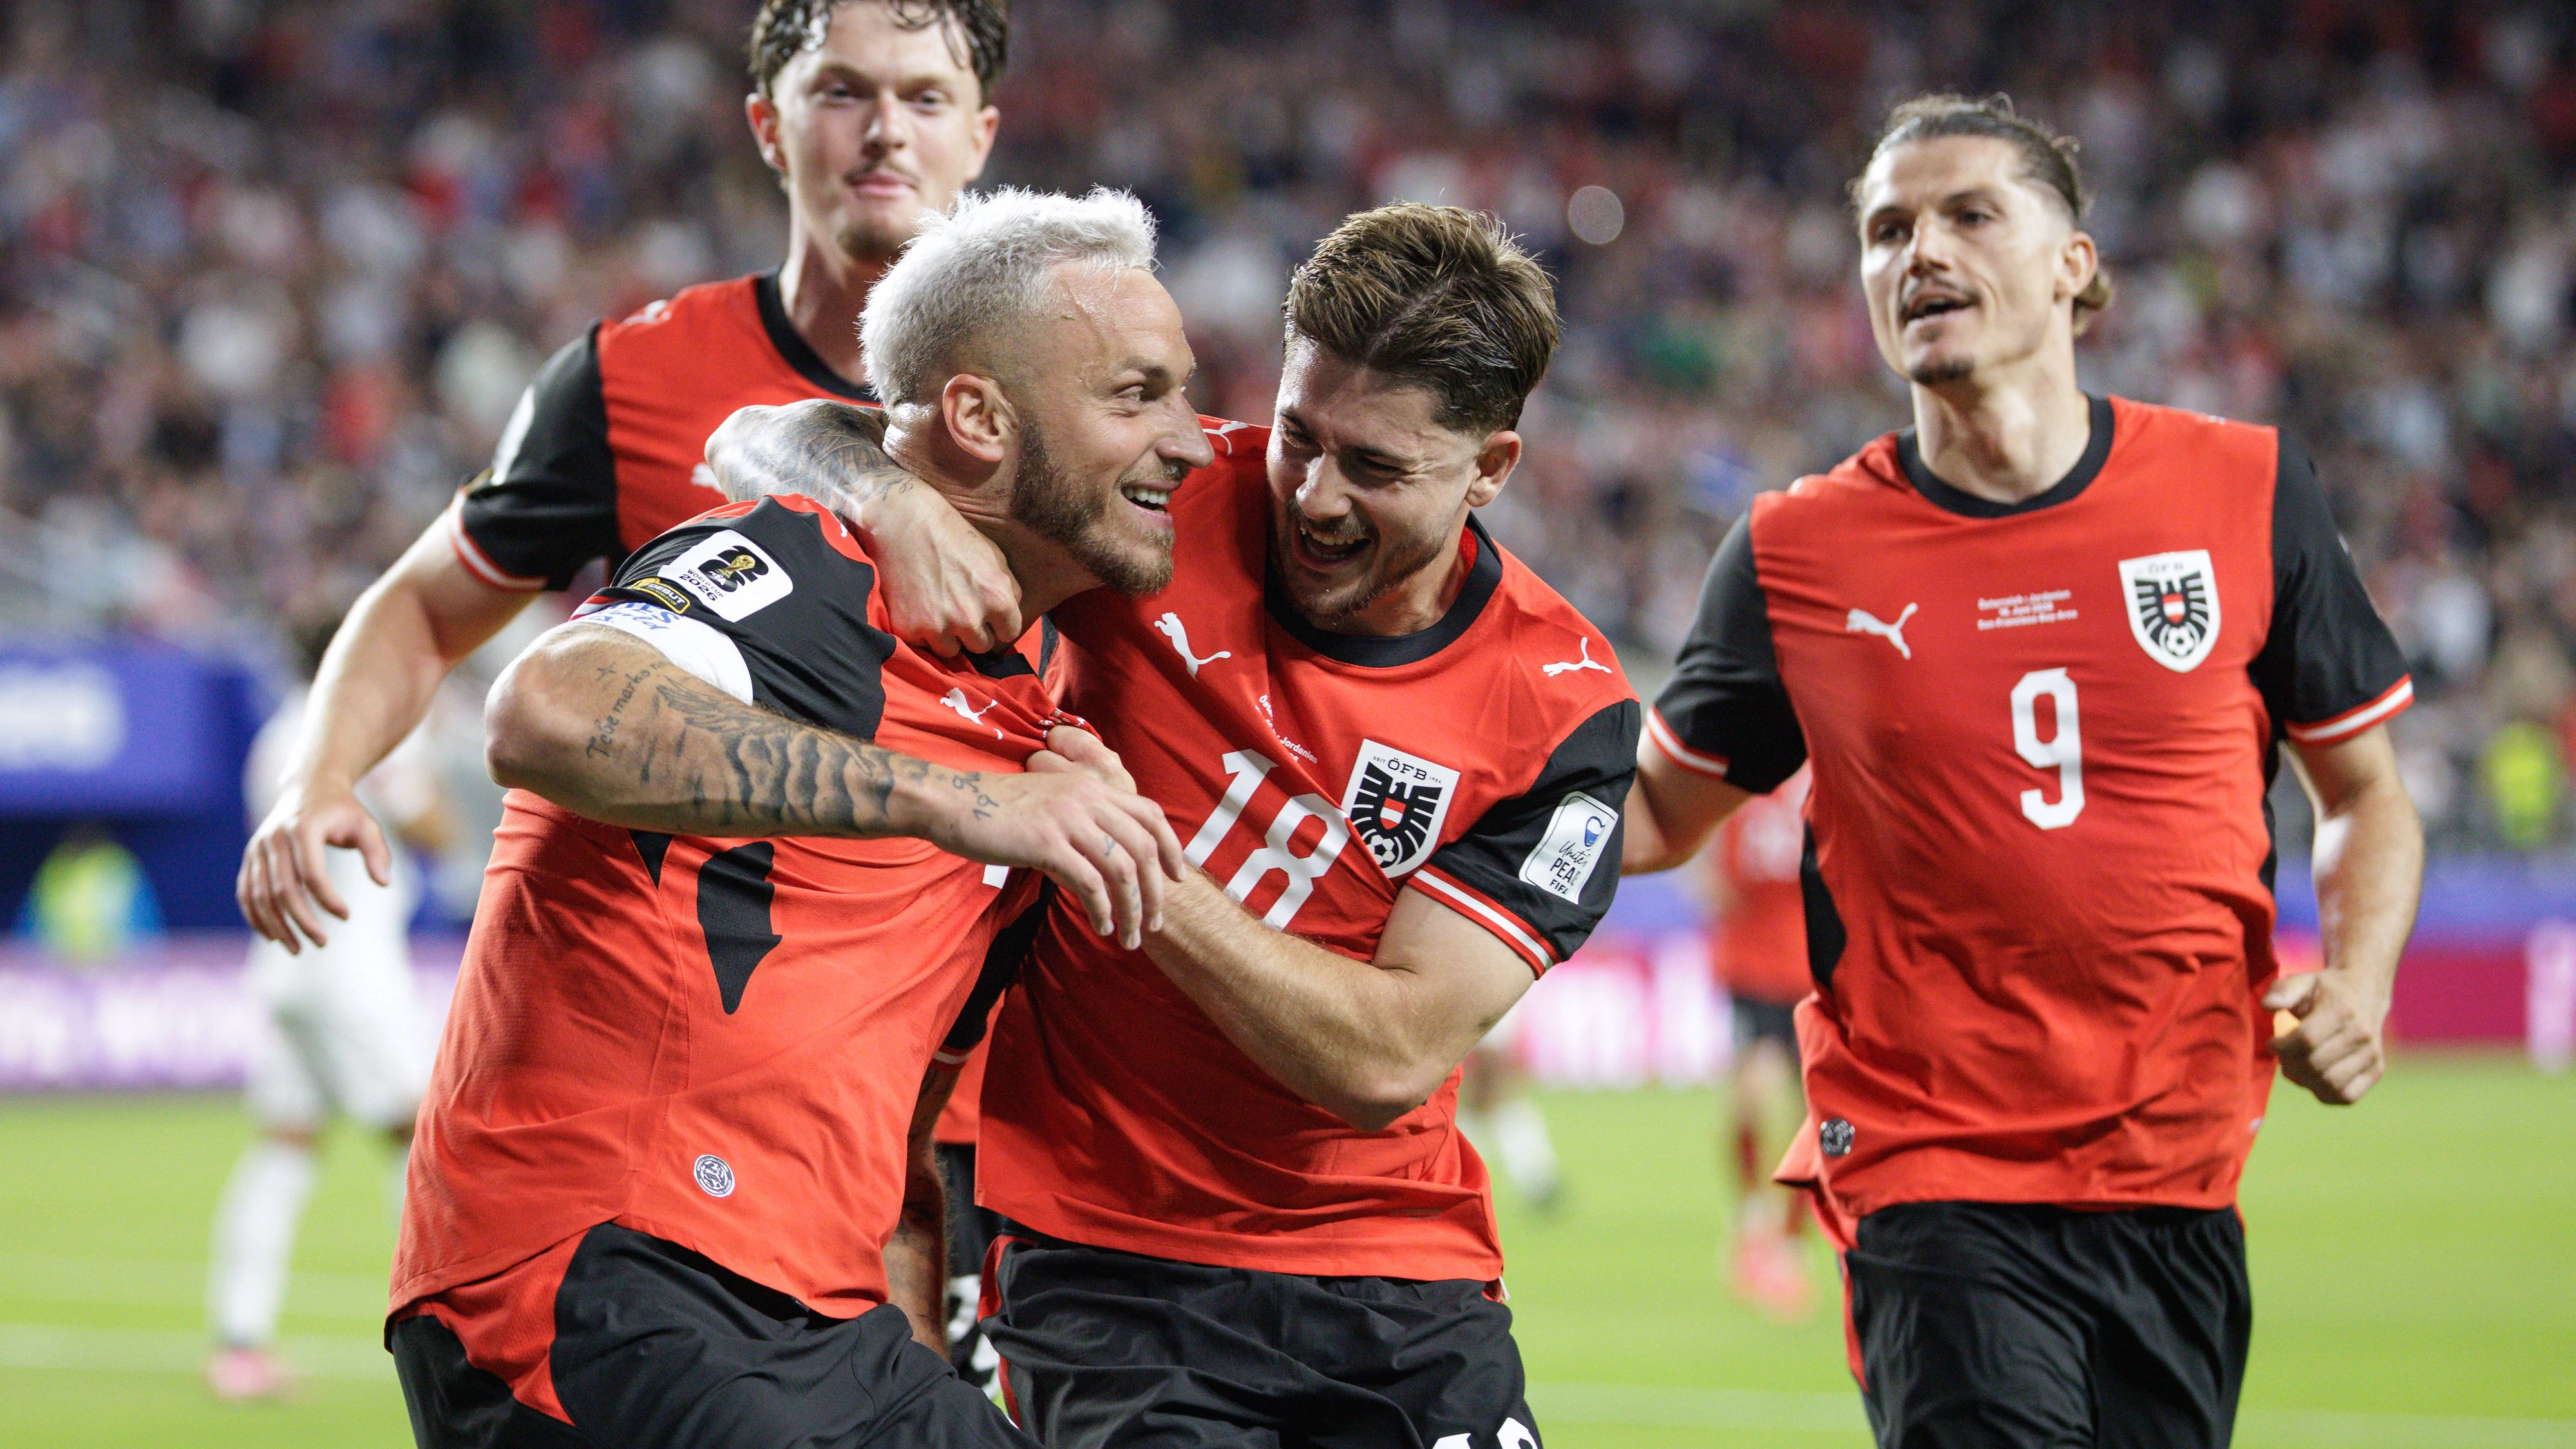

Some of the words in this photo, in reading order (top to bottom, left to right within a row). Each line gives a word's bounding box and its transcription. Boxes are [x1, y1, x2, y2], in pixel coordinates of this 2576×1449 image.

[648, 583, 686, 603] DEBUT
[679, 574, 718, 601] 2026
[687, 569, 711, 586] WORLD
[710, 586, 724, 598] CUP
[1280, 737, 1318, 764] Jordanien
[2011, 667, 2085, 829] 9
[1388, 757, 1427, 781] ÖFB
[1183, 748, 1351, 932] 18
[1549, 857, 1580, 886] PEA
